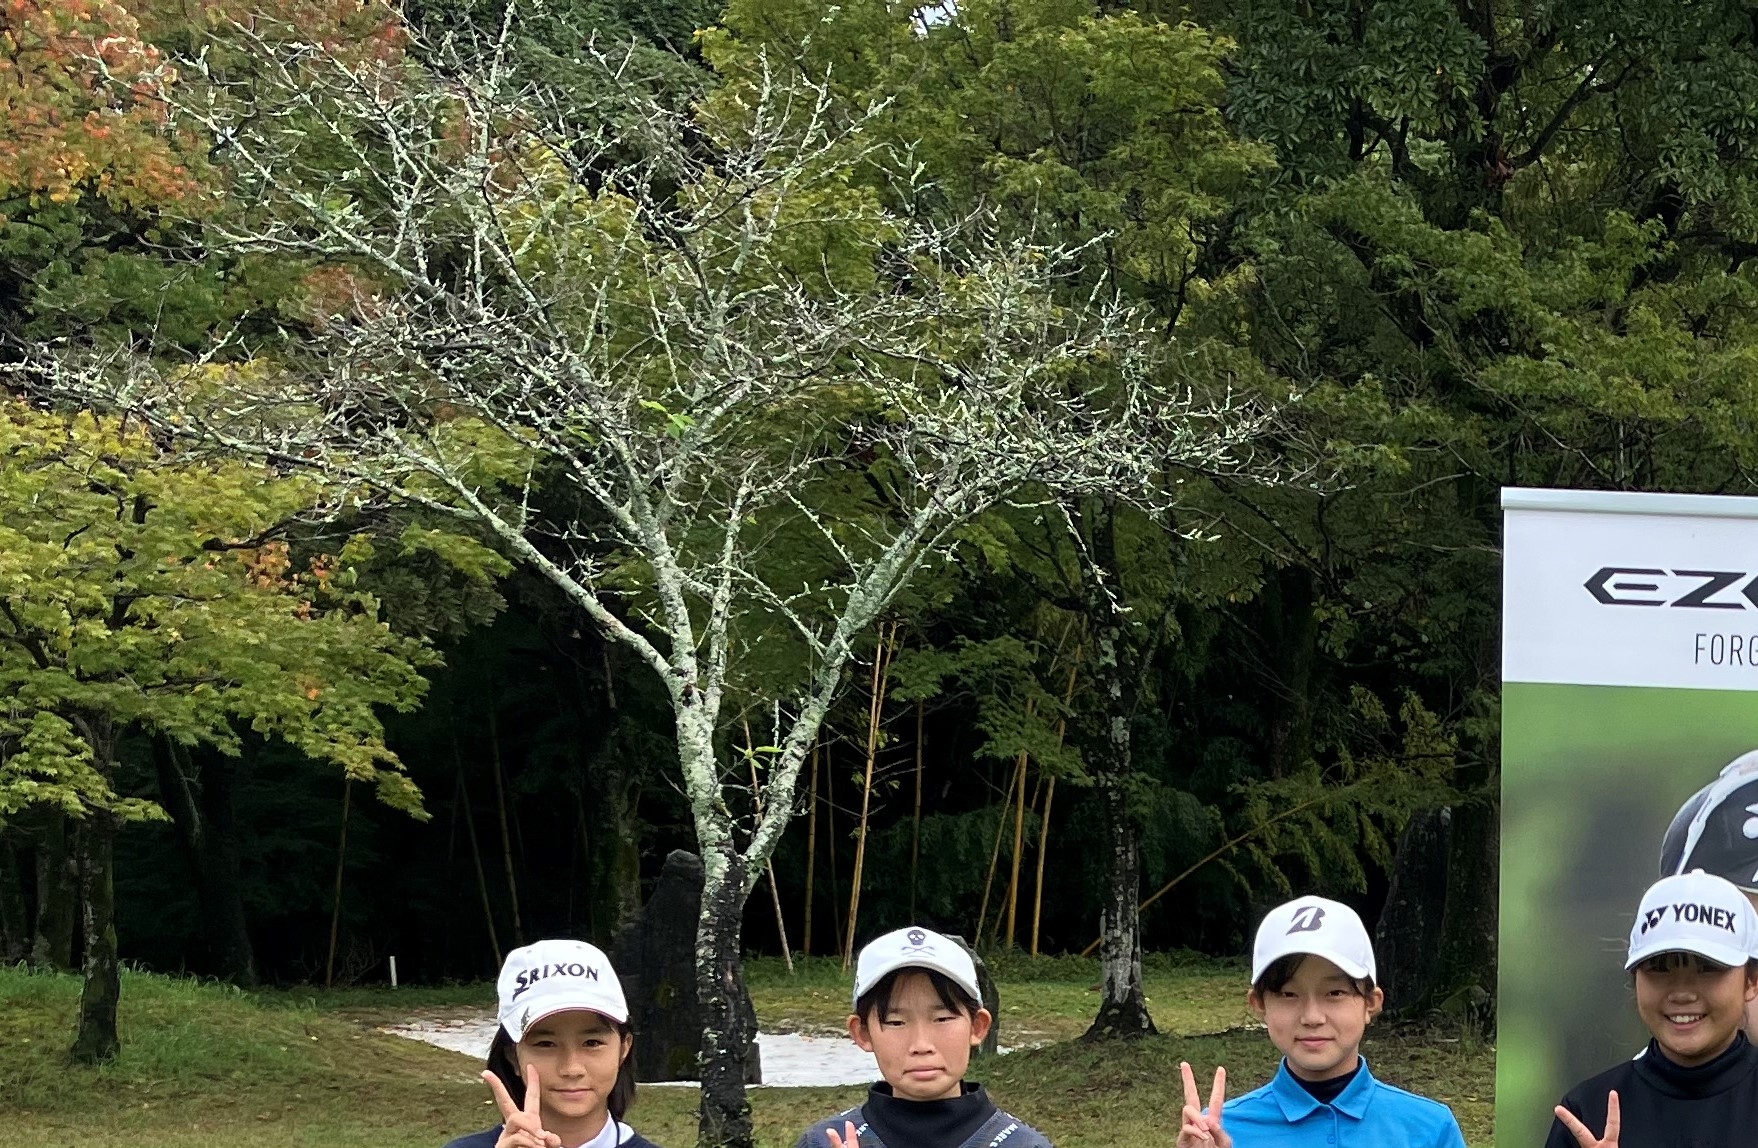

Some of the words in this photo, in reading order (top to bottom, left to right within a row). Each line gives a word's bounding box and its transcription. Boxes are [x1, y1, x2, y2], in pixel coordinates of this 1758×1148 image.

[1672, 903, 1737, 935] YONEX
[512, 963, 599, 1002] SRIXON
[994, 1123, 1018, 1142] MARK
